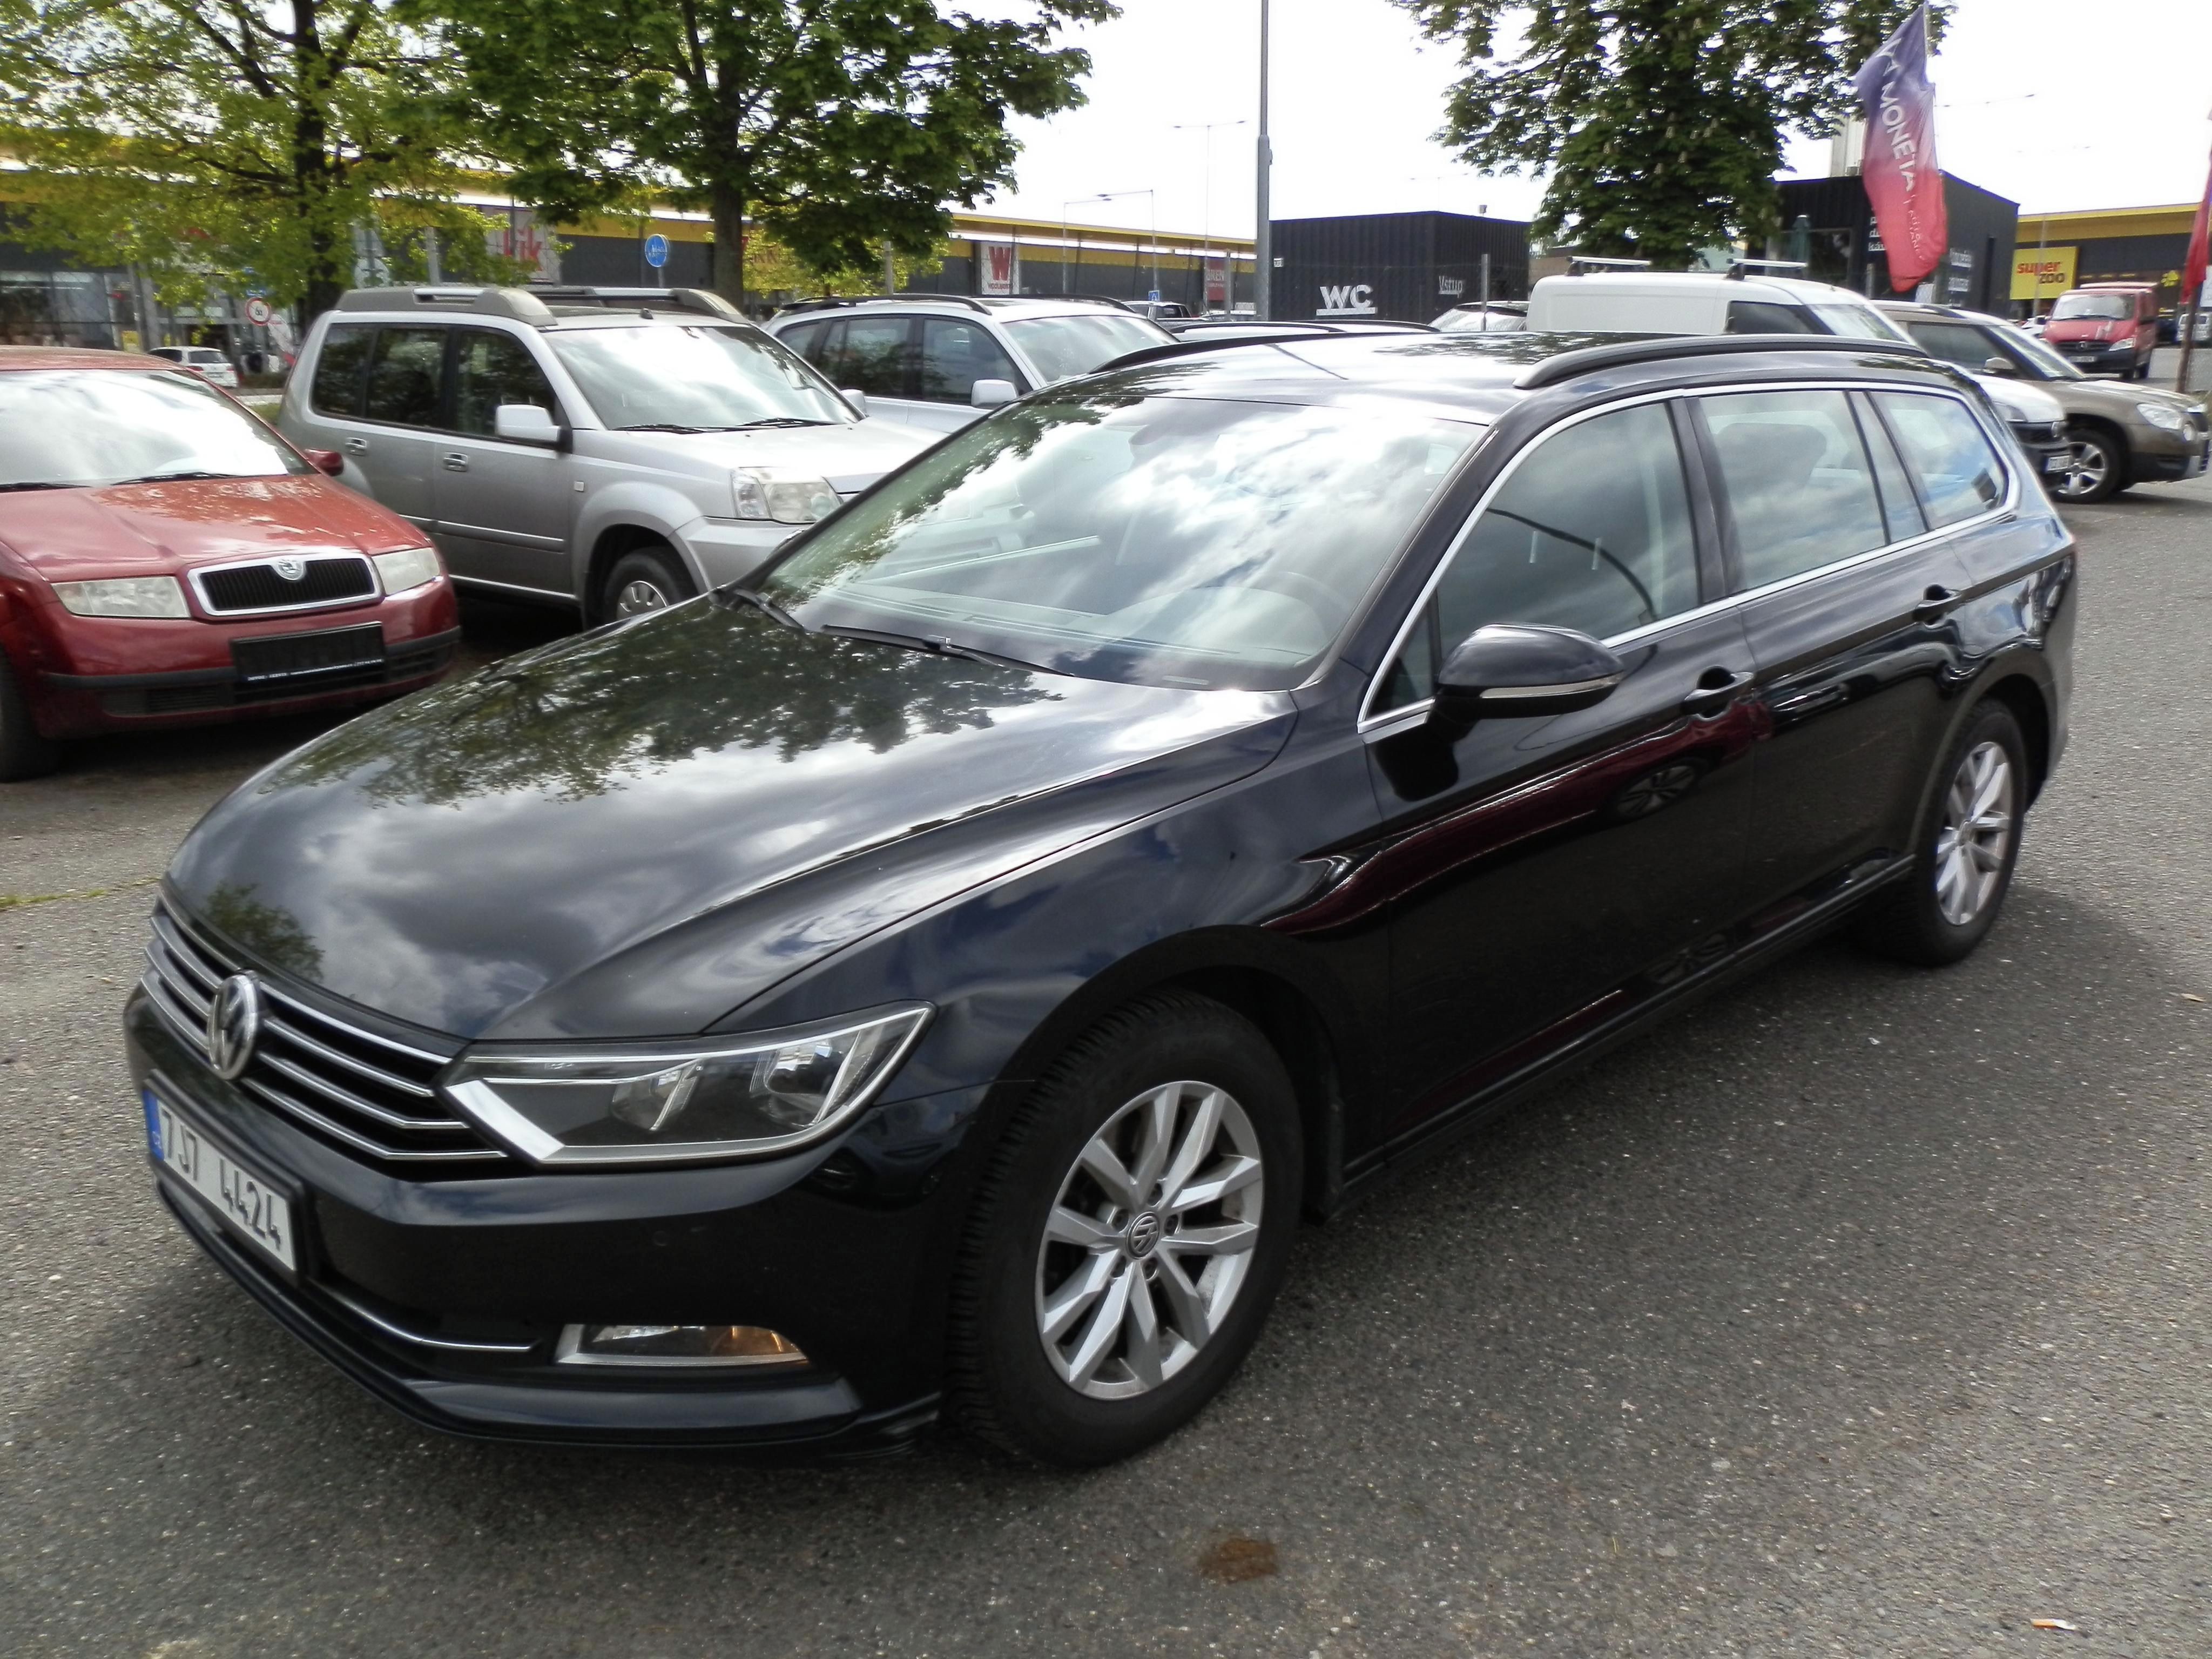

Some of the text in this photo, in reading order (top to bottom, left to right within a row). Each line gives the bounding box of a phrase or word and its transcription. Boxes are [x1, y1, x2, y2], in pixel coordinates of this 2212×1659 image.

[1880, 81, 1916, 192] MONETA
[2017, 261, 2061, 276] super
[1320, 285, 1373, 309] WC
[1439, 275, 1463, 298] Vstup
[219, 1159, 281, 1251] 4424
